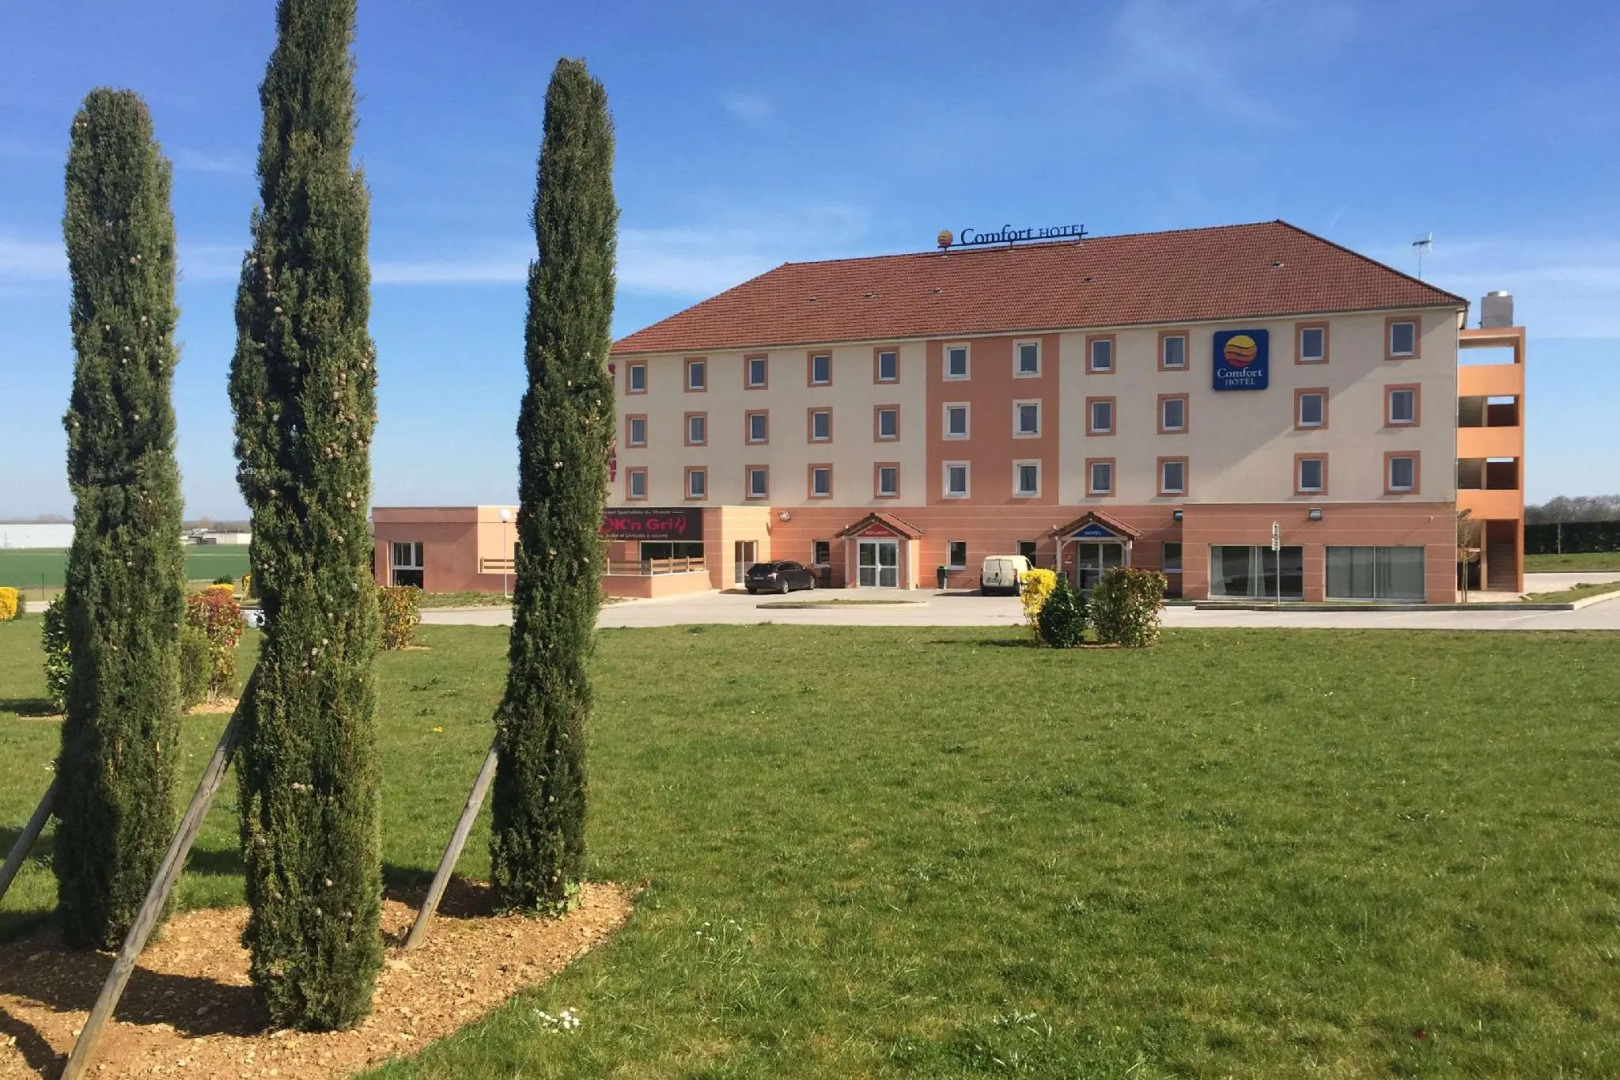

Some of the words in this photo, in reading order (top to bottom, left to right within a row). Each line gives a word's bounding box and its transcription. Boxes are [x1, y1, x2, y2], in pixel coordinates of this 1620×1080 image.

[960, 224, 1034, 245] Comfort
[1039, 224, 1085, 238] HOTEL
[1217, 367, 1263, 379] Comfort
[1224, 378, 1256, 386] HOTEL
